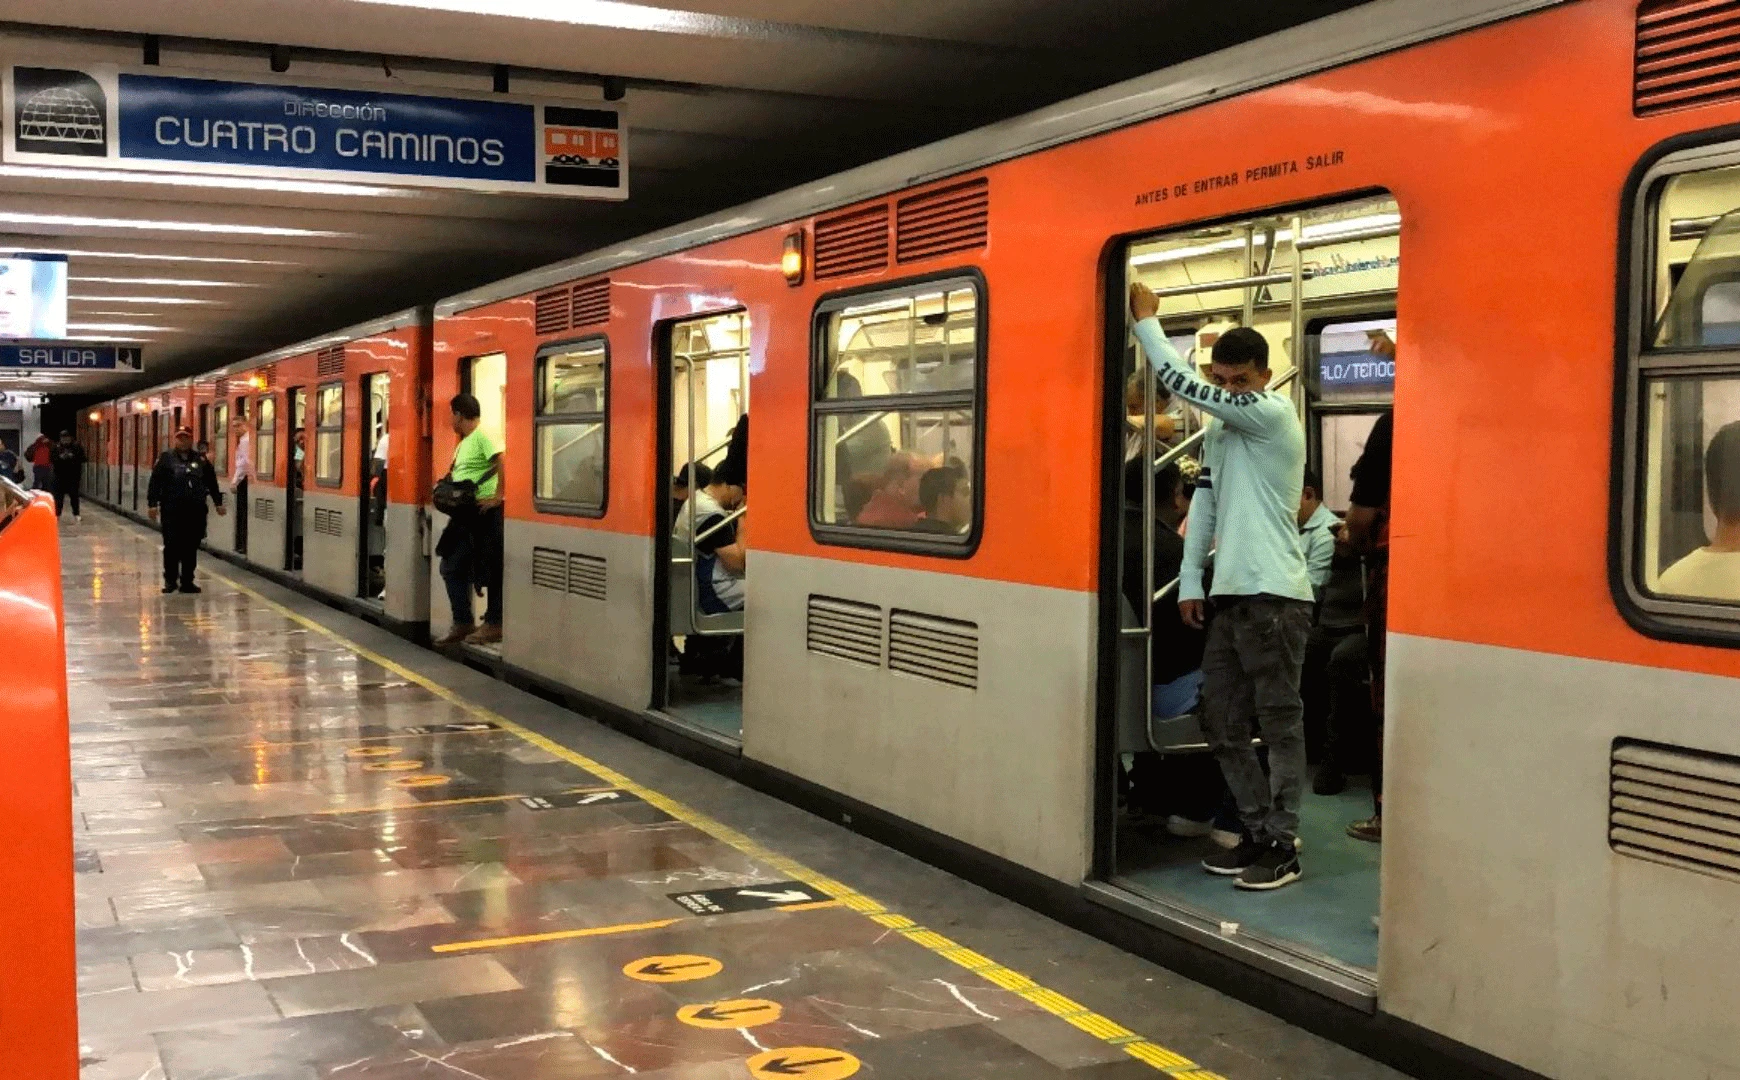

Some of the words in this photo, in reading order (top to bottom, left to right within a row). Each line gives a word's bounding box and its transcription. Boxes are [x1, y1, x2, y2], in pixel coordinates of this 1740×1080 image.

[155, 116, 316, 154] CUATRO
[335, 128, 505, 166] CAMINOS
[1135, 187, 1168, 206] ANTES
[1174, 183, 1187, 197] DE
[1194, 172, 1238, 193] ENTRAR
[1246, 160, 1298, 183] PERMITA
[1306, 151, 1344, 170] SALIR
[19, 348, 97, 366] SALIDA
